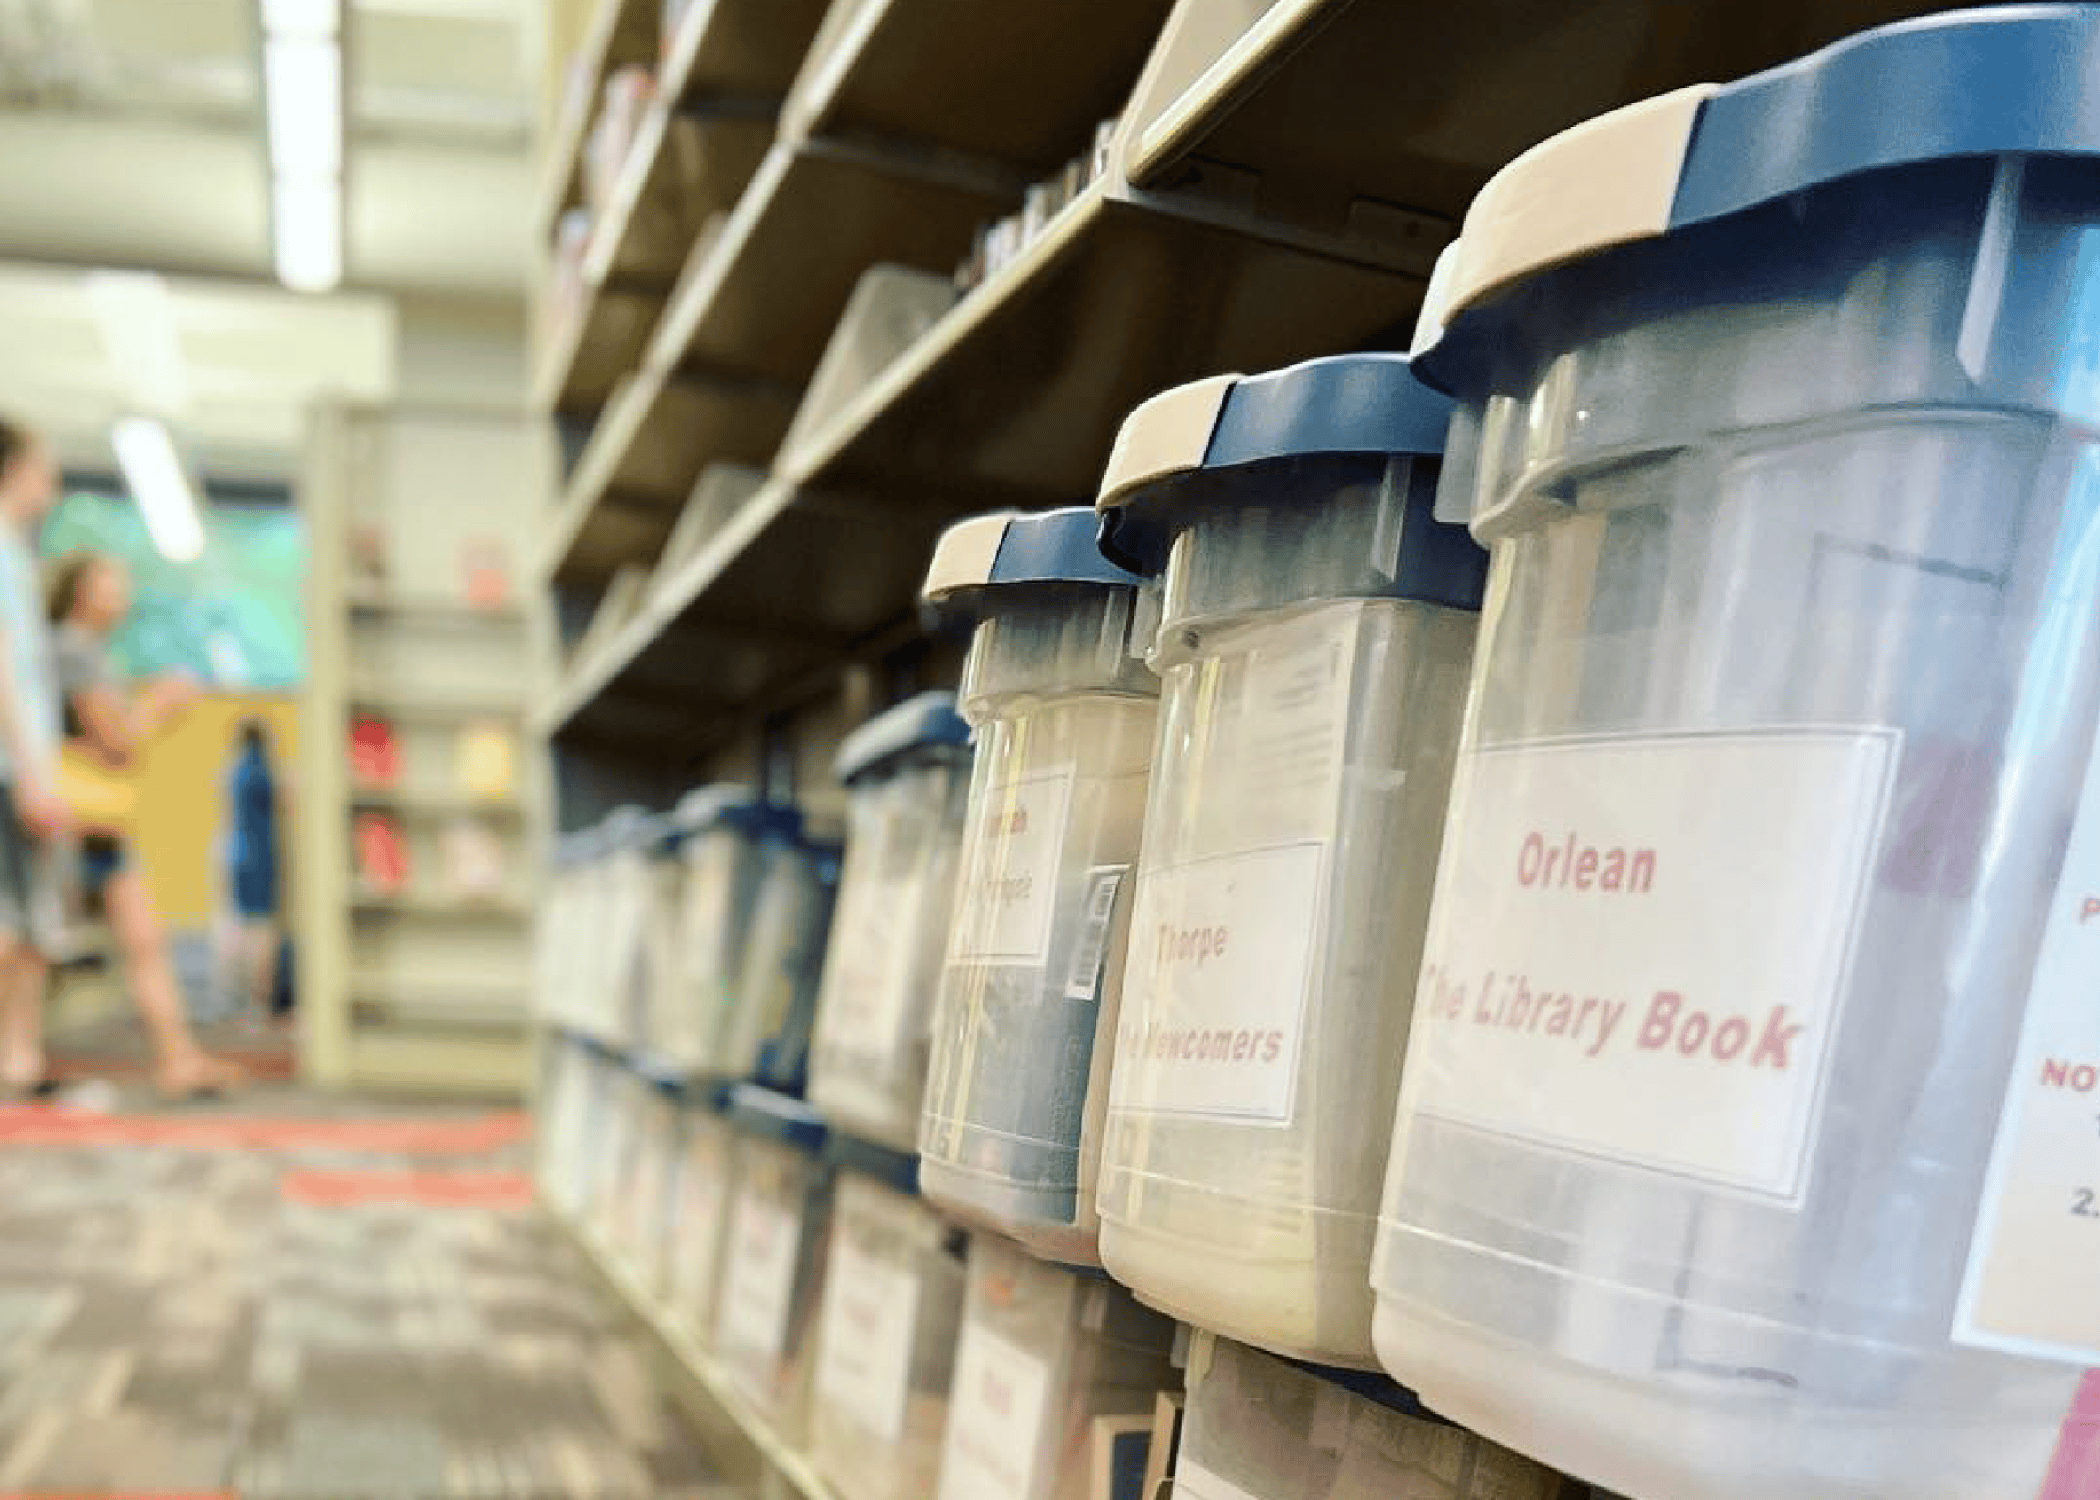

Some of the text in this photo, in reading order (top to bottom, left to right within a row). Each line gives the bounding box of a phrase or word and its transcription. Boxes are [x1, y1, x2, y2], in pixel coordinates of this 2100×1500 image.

[1517, 830, 1657, 893] Orlean
[1471, 970, 1627, 1059] Library
[1635, 989, 1808, 1071] Book
